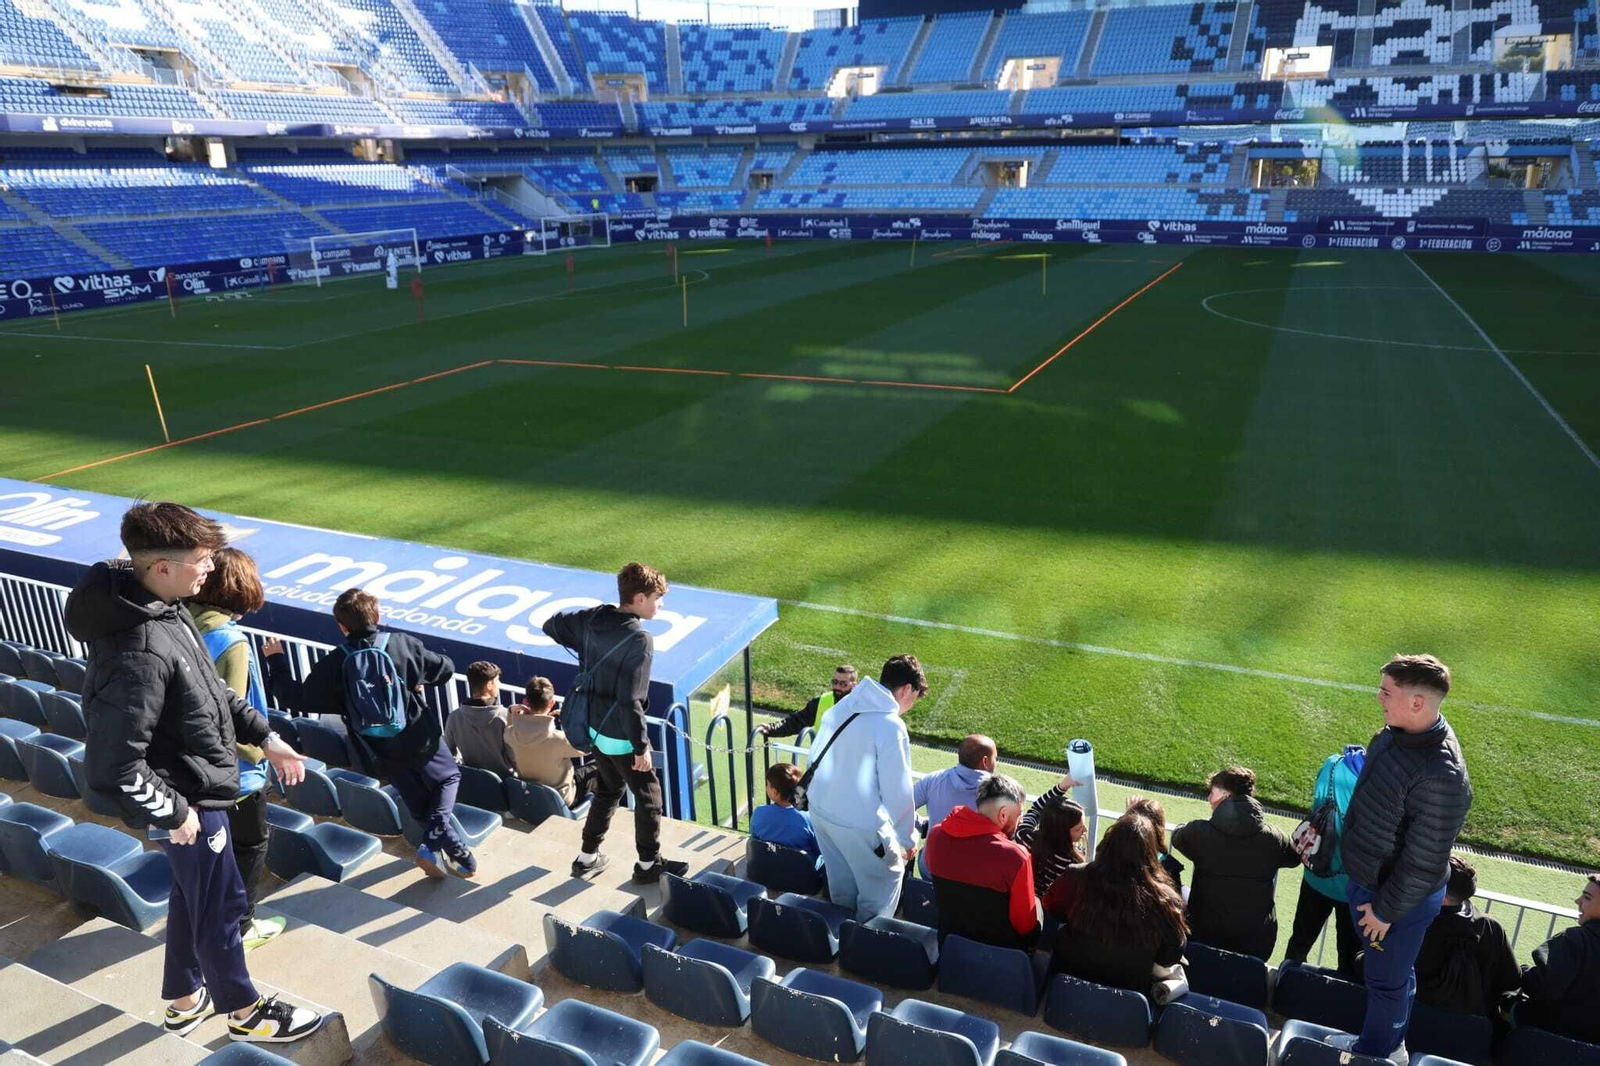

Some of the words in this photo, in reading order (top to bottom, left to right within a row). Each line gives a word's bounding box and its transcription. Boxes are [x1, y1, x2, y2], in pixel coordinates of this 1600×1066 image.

[524, 127, 550, 138] vithas
[660, 126, 692, 136] hummel
[725, 124, 756, 134] hummel
[1162, 221, 1197, 232] vithas
[646, 229, 679, 240] vithas
[1522, 226, 1572, 239] málaga
[322, 248, 351, 258] campano
[446, 250, 472, 262] vithas
[352, 259, 382, 272] hummel
[78, 273, 132, 291] vithas
[103, 284, 152, 299] SWM
[378, 604, 488, 635] edonda
